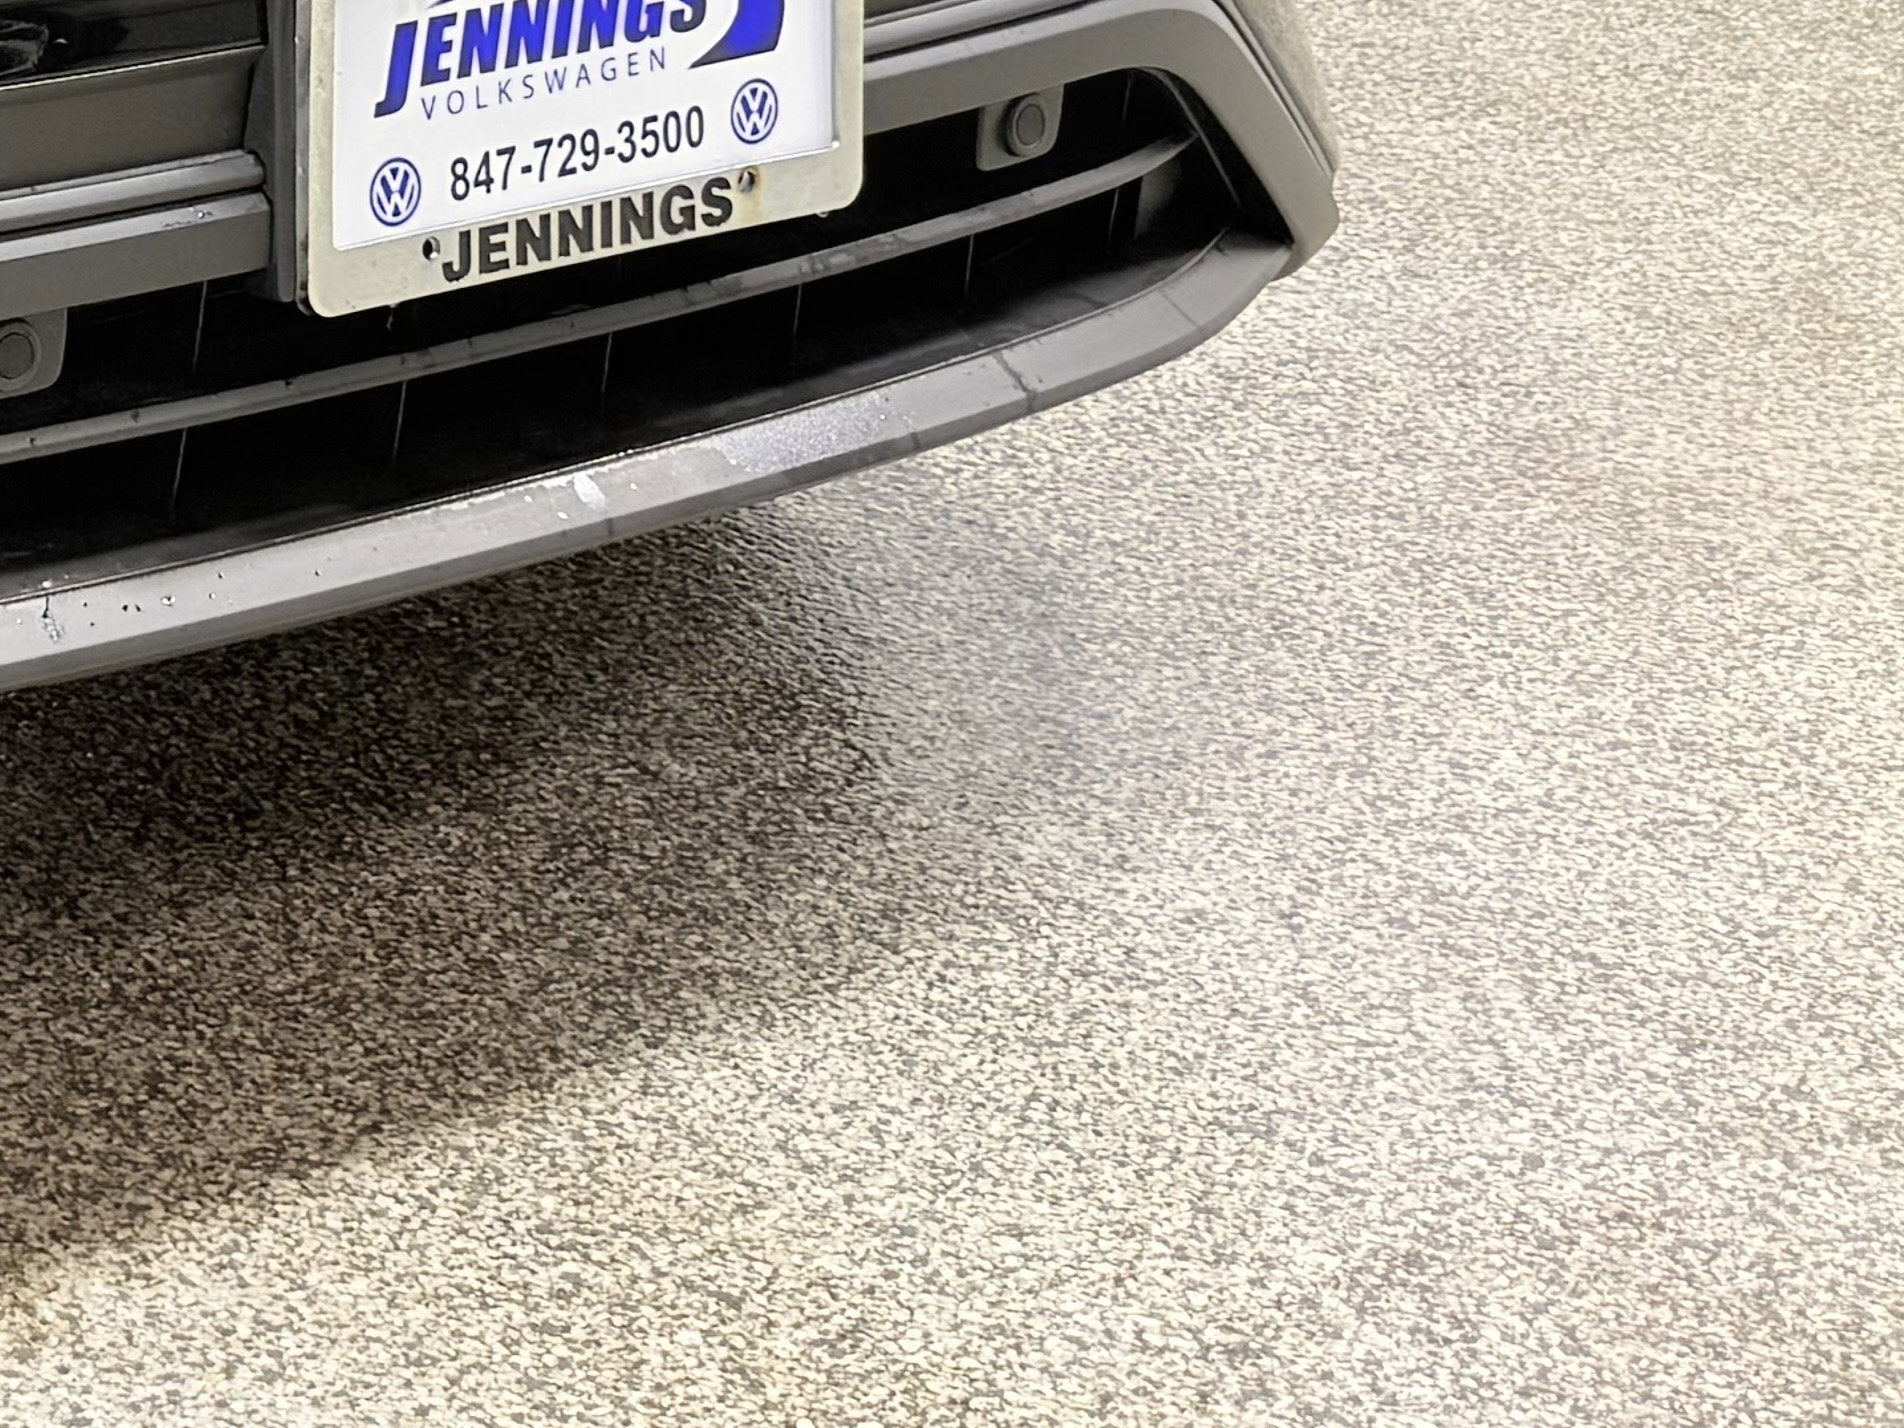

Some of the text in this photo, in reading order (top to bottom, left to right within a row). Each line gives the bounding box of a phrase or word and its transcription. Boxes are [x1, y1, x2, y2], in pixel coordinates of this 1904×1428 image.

[421, 45, 668, 121] VOLKSWAGEN
[449, 105, 705, 202] 847-729-3500
[442, 176, 733, 283] JENNINGS
